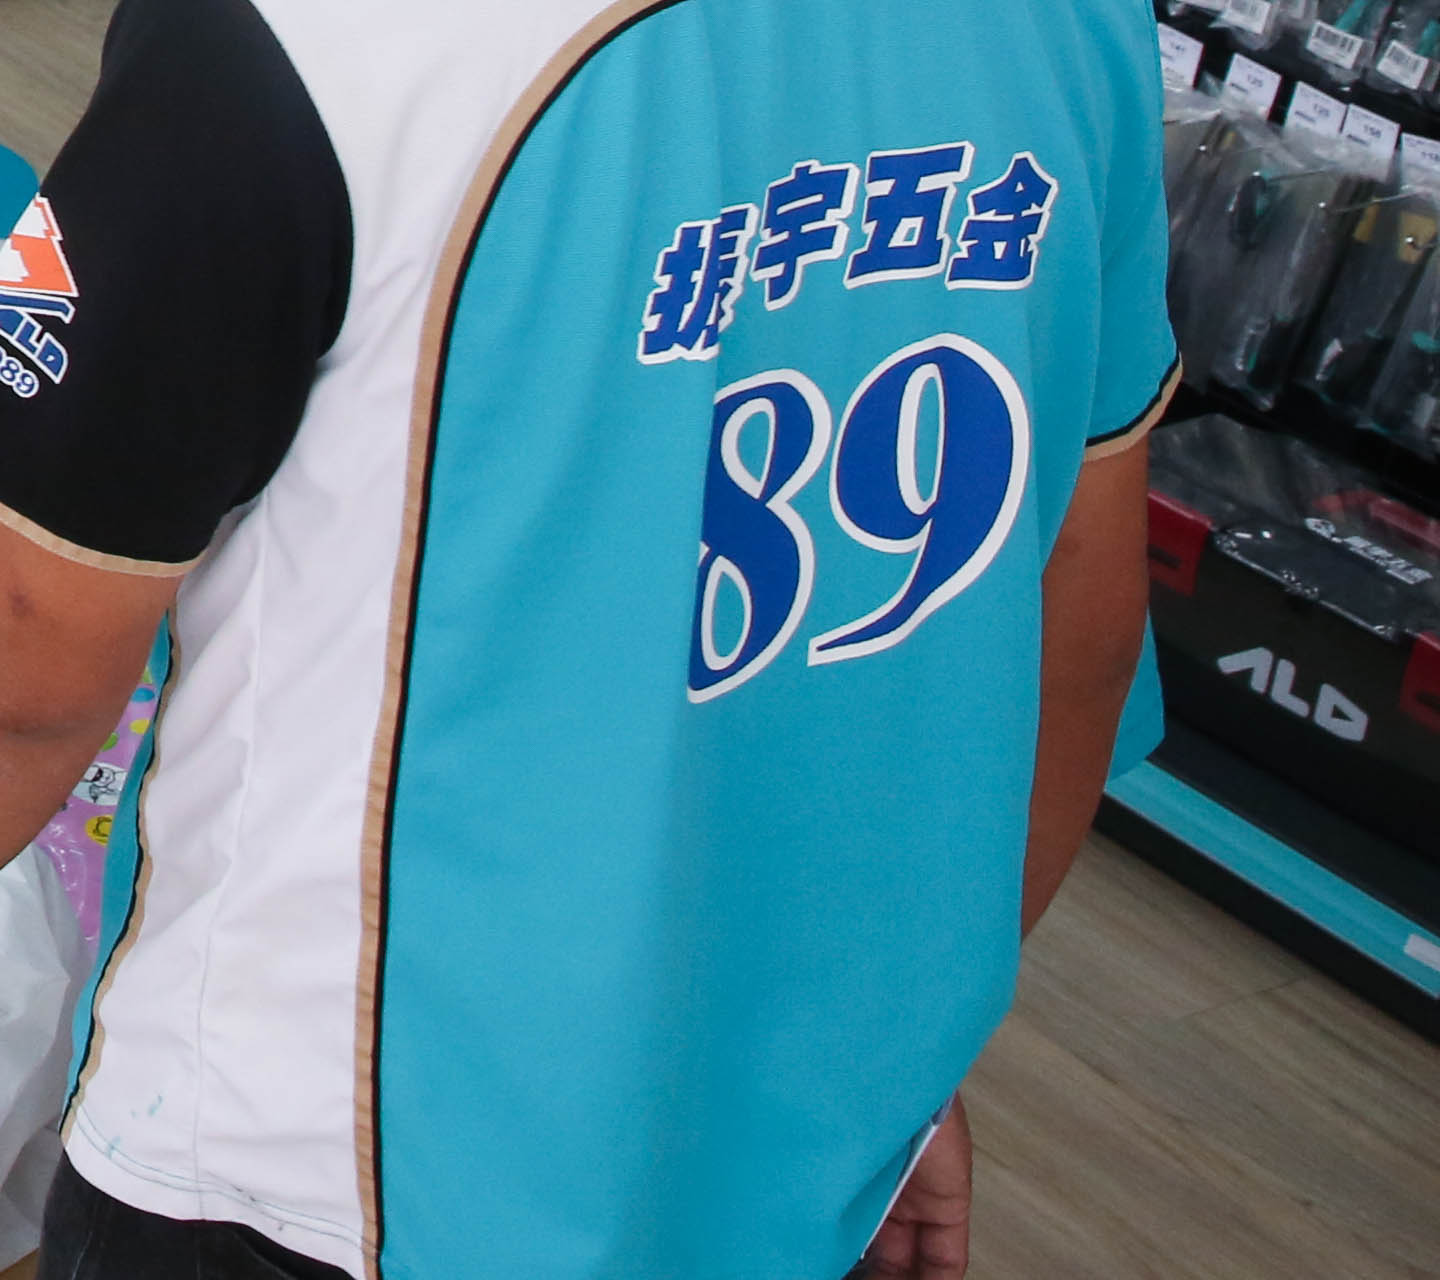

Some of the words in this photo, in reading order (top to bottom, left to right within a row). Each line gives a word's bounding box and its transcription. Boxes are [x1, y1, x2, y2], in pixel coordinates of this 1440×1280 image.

[636, 140, 1059, 366] 振宇五金
[686, 332, 1030, 704] 89
[1216, 645, 1370, 742] ALD
